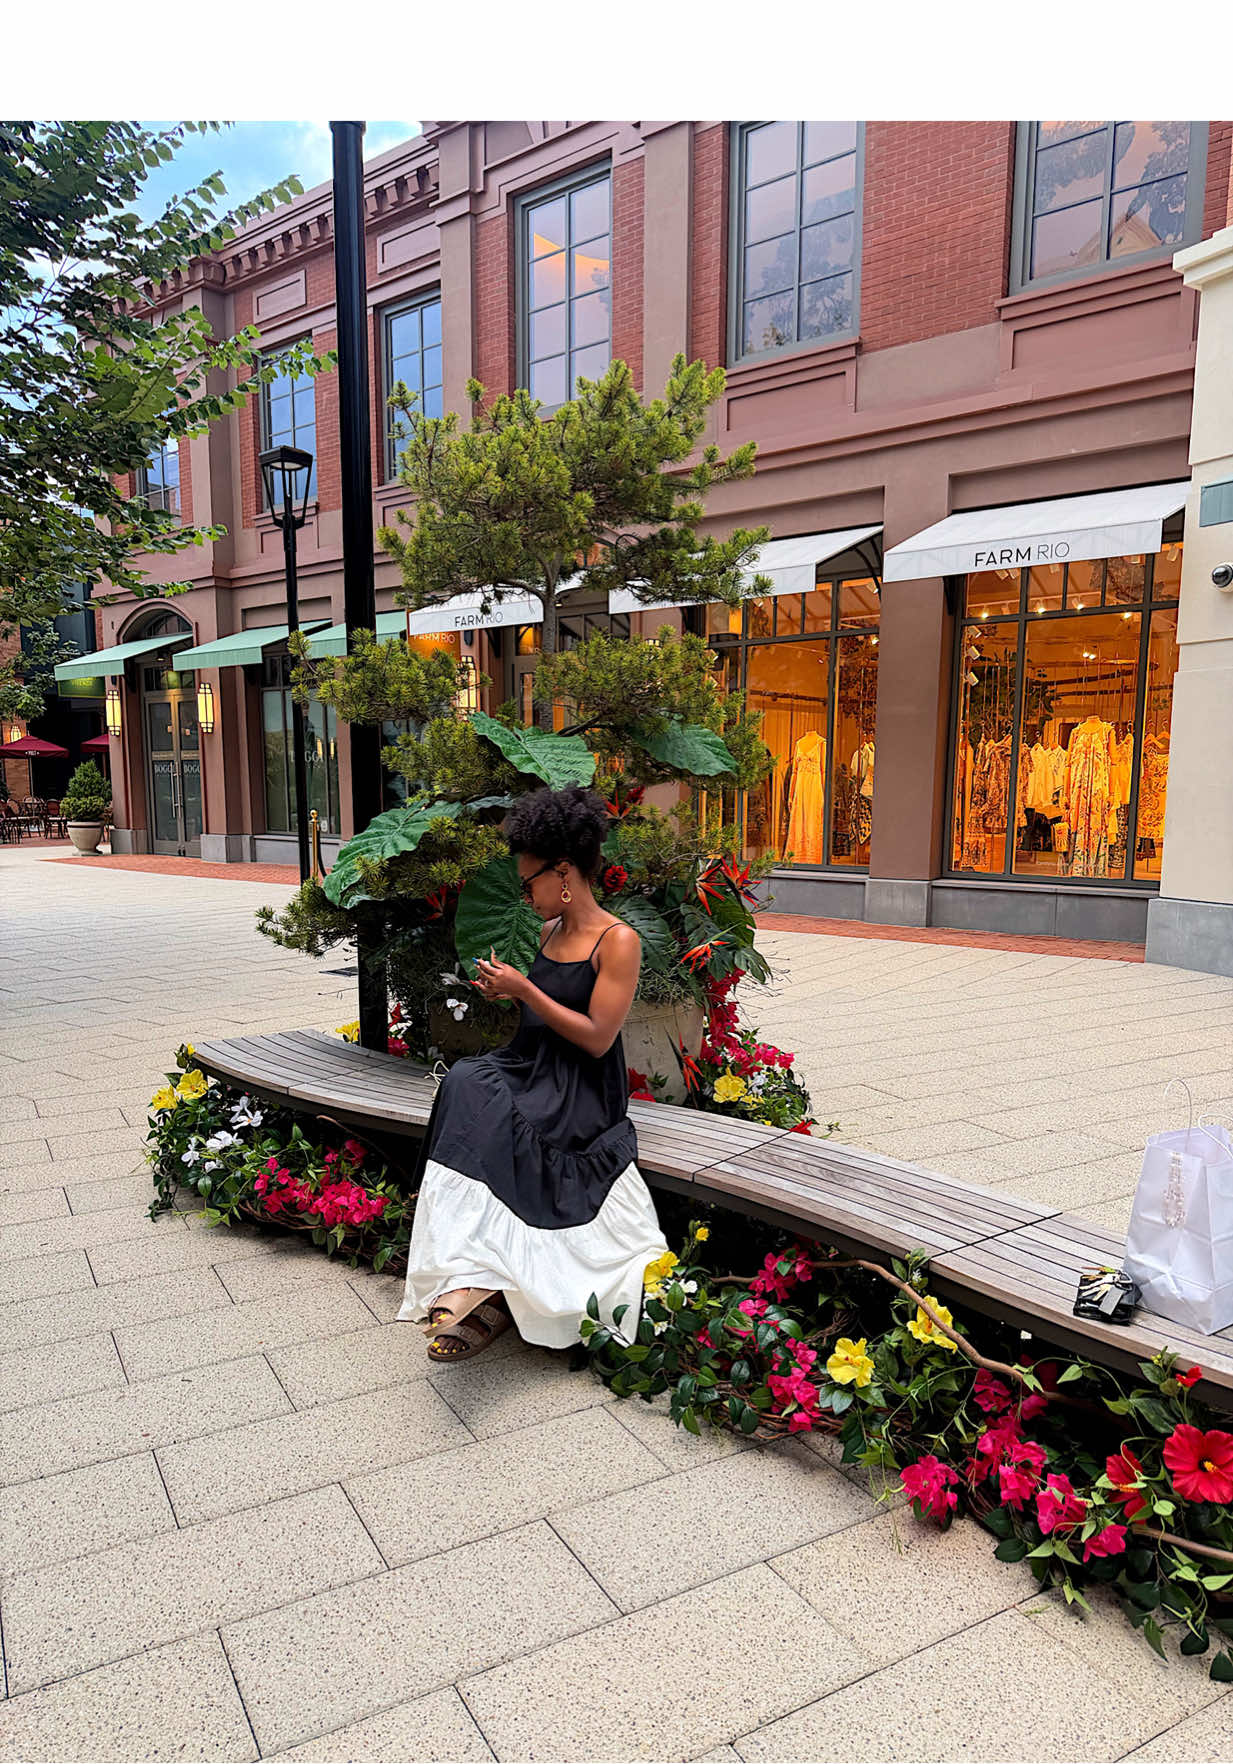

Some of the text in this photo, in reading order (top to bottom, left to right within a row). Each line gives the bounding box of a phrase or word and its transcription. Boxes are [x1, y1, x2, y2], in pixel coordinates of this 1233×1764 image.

[974, 541, 1070, 567] FARM RIO
[454, 611, 504, 627] FARM RIO
